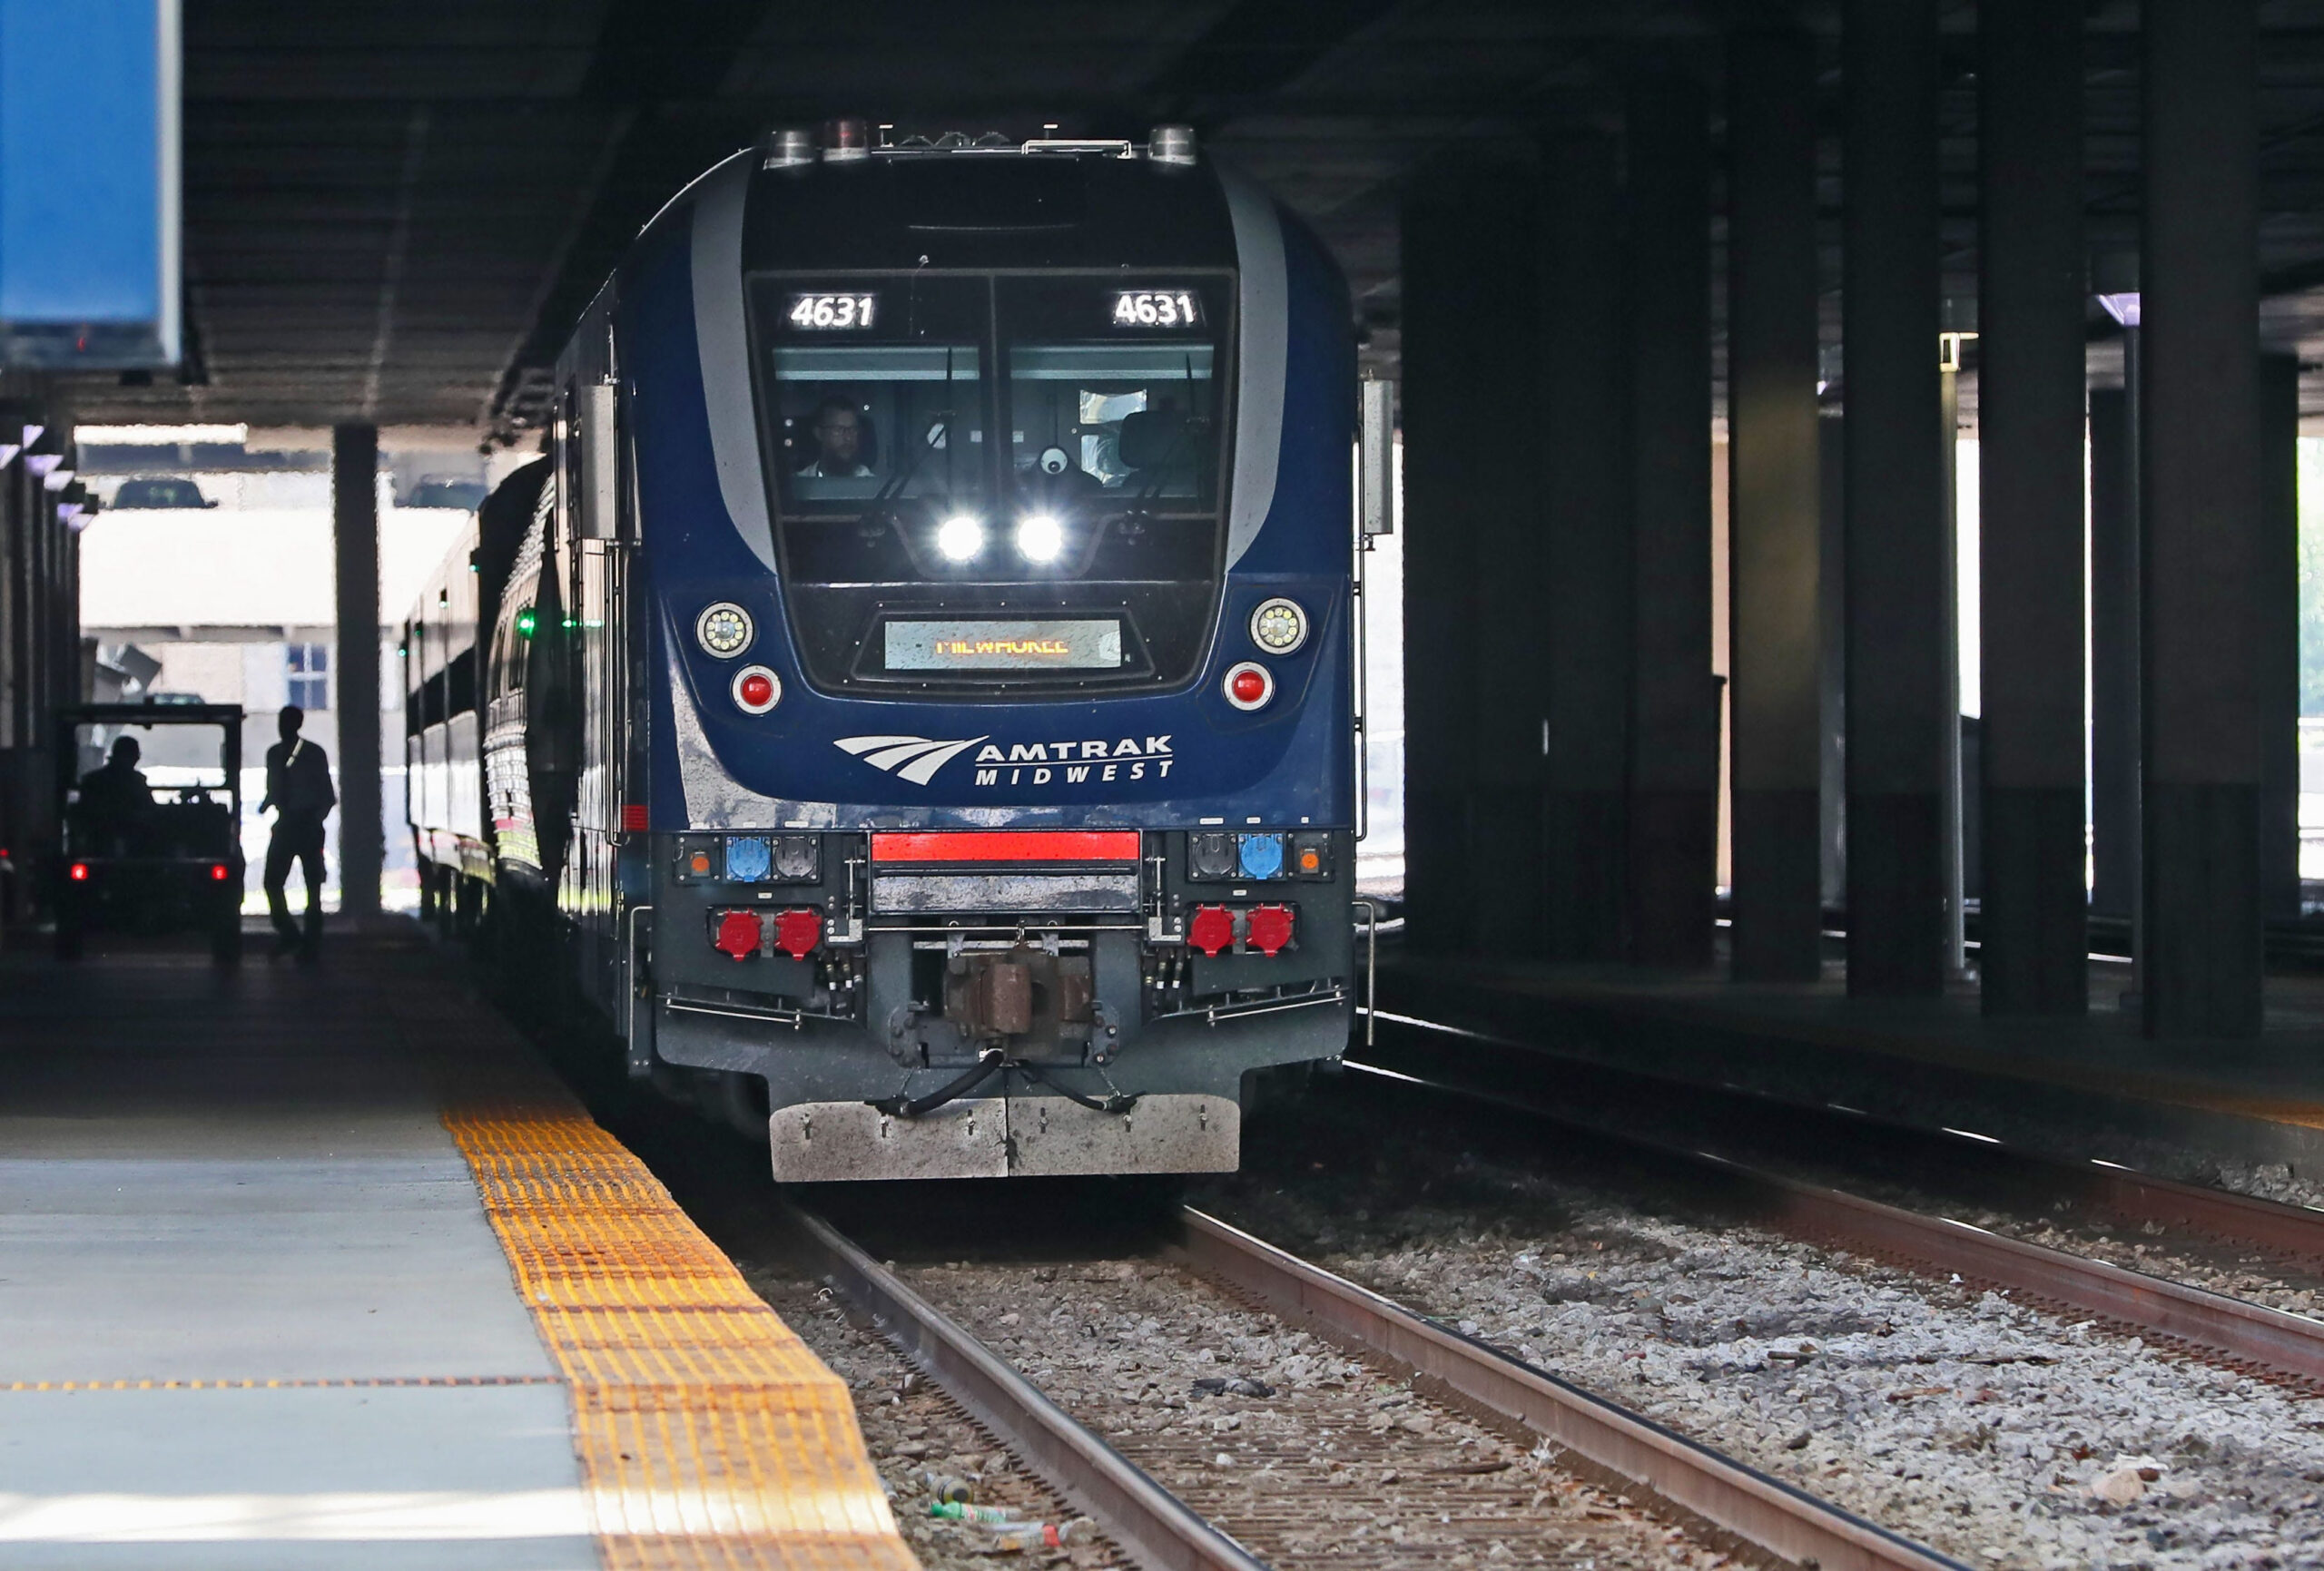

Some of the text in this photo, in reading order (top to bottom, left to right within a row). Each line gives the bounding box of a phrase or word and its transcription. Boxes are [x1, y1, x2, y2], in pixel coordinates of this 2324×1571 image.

[790, 296, 873, 327] 4631
[1114, 294, 1195, 324] 4631
[975, 735, 1173, 762] AMTRAK
[974, 761, 1174, 786] MIDWEST
